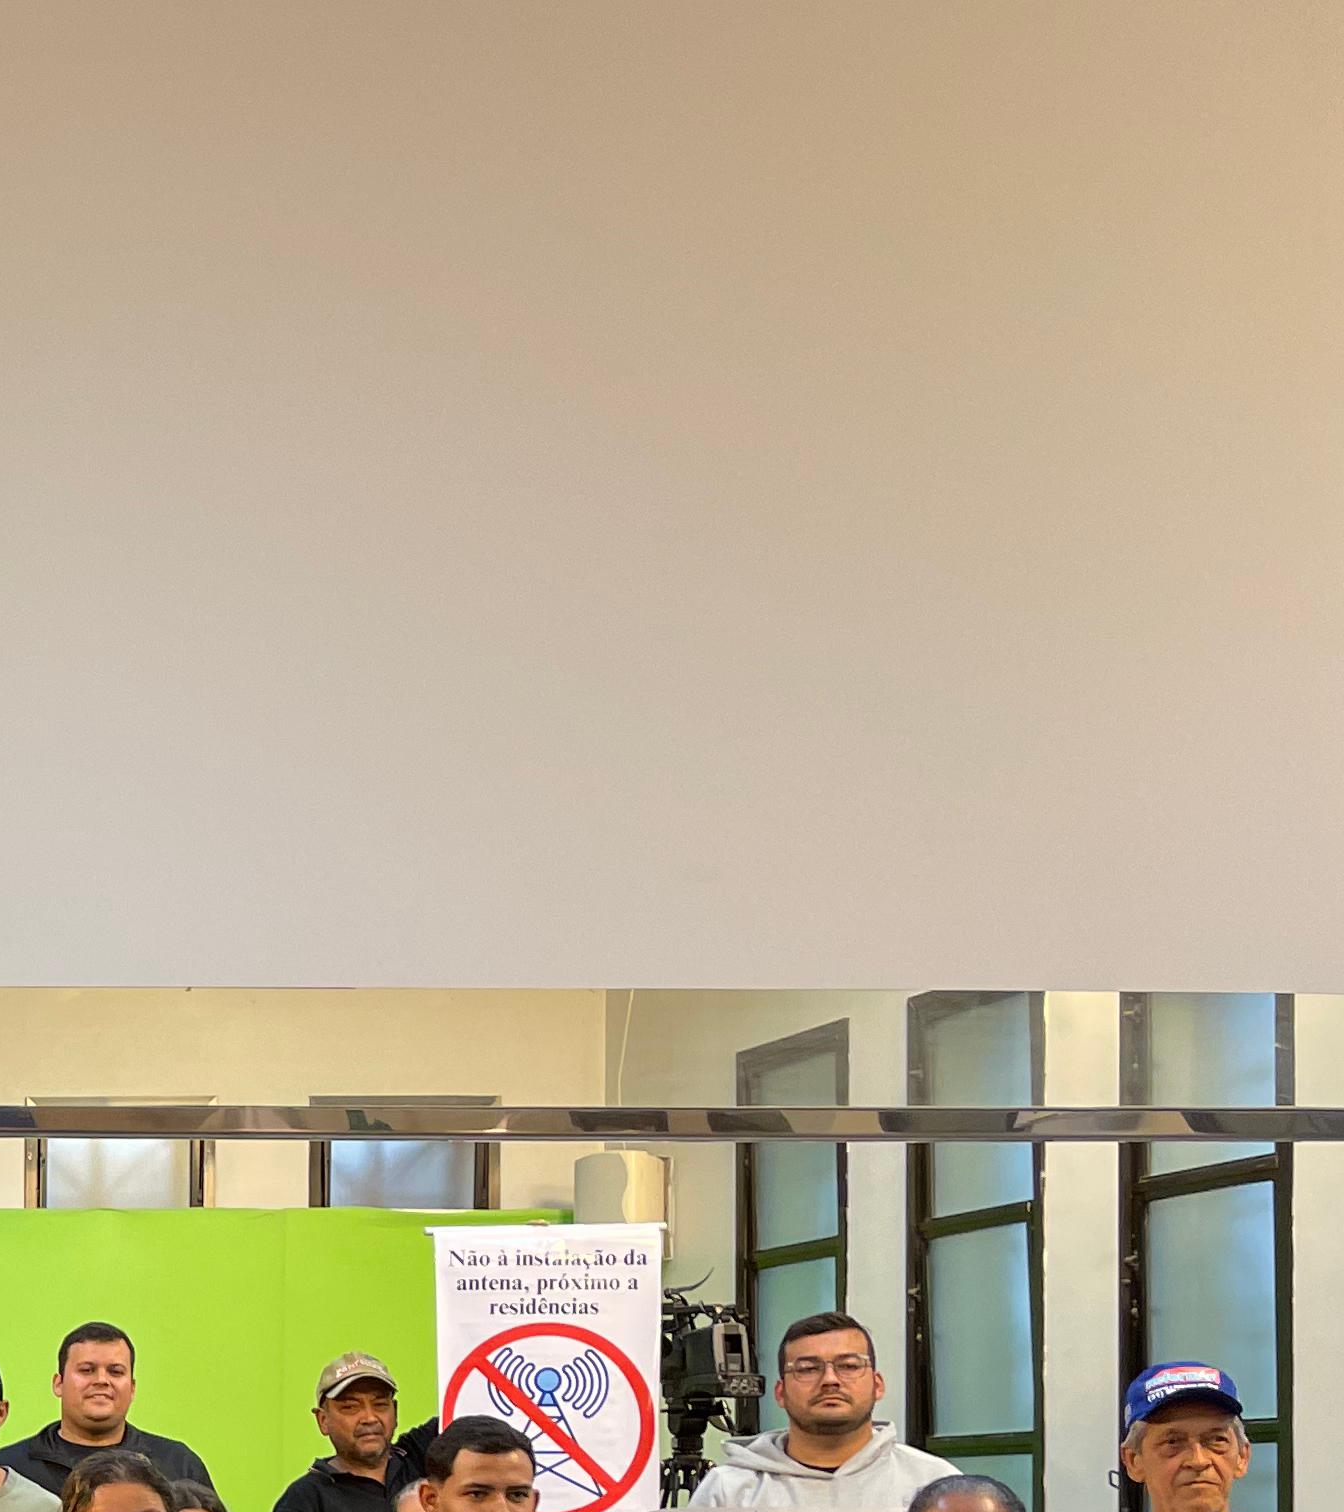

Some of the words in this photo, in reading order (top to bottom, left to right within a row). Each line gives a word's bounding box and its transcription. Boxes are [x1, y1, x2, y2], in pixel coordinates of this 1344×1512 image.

[448, 1249, 490, 1267] Não
[497, 1249, 508, 1266] à
[515, 1249, 617, 1270] instalação
[623, 1249, 647, 1266] da
[456, 1275, 530, 1293] antena,
[537, 1273, 620, 1294] próximo
[627, 1277, 639, 1290] a
[489, 1297, 599, 1316] residências
